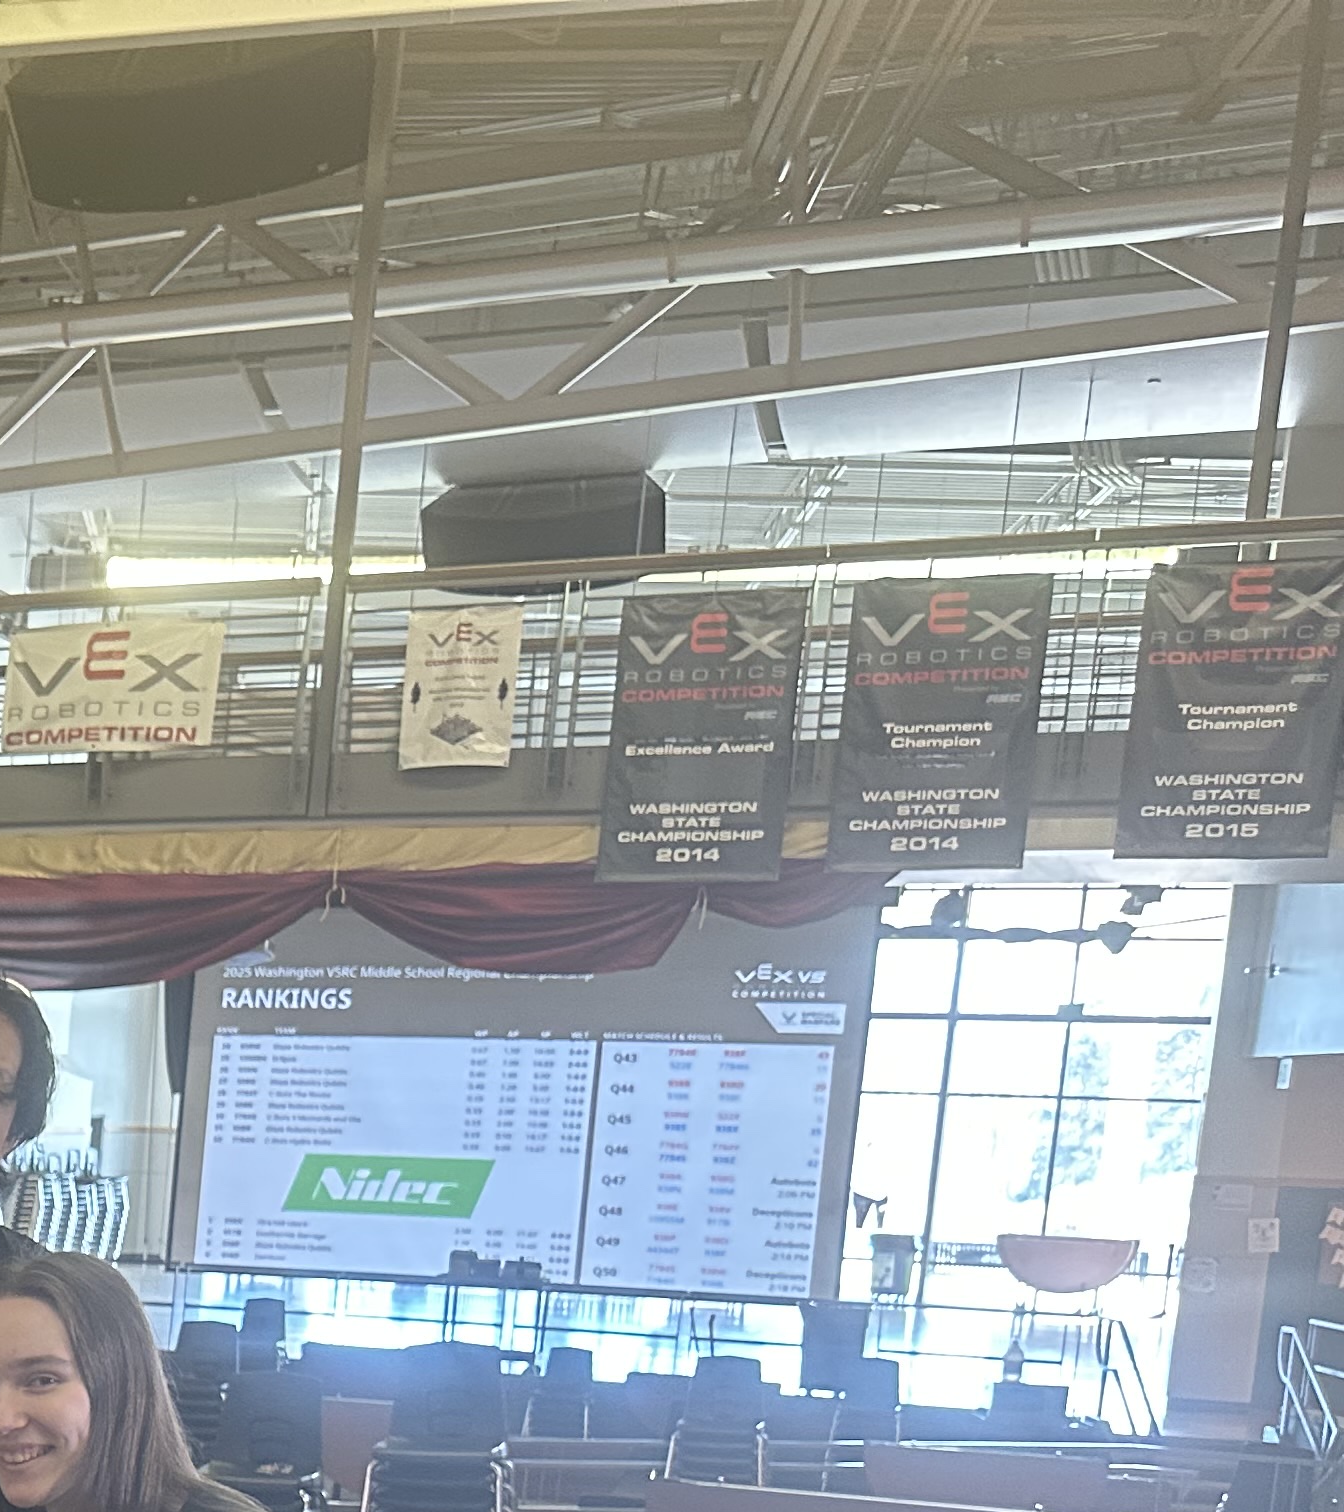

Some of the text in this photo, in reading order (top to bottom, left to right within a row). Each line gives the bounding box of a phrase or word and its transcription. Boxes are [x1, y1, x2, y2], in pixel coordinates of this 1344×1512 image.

[1158, 566, 1344, 624] VEX
[862, 592, 1034, 647] VEX
[428, 622, 500, 648] VEX
[628, 613, 789, 665] VEX
[1150, 623, 1341, 645] ROBOTICS
[856, 646, 1033, 667] ROBOTICS
[1148, 645, 1338, 665] COMPETITION
[14, 631, 202, 697] VEX
[623, 665, 788, 684] ROBOTICS
[854, 667, 1030, 686] COMPETITION
[622, 685, 785, 704] COMPETITION
[8, 700, 200, 722] ROBOTICS
[1178, 702, 1298, 715] Tournament
[882, 721, 993, 735] Tournament
[1186, 718, 1285, 731] Champion
[5, 726, 197, 746] COMPETITION
[890, 735, 981, 749] Champion
[625, 740, 775, 757] Excellence Award
[1154, 773, 1304, 787] WASHINGTON
[862, 788, 1000, 802] WASHINGTON
[1192, 789, 1261, 801] STATE
[629, 801, 758, 815] WASHINGTON
[897, 804, 960, 816] STATE
[1140, 803, 1311, 817] CHAMPIONSHIP
[662, 816, 721, 828] STATE
[849, 817, 1007, 832] CHAMPIONSHIP
[617, 830, 764, 843] CHAMPIONSHIP
[1185, 823, 1259, 838] 2015
[890, 836, 959, 851] 2014
[656, 847, 720, 863] 2014
[223, 966, 251, 979] 2025
[254, 967, 324, 981] Washington
[360, 966, 402, 979] Middle
[404, 968, 444, 979] School
[735, 963, 792, 983] VEX
[221, 987, 353, 1010] RANKINGS
[732, 990, 825, 998] COMPETITION
[608, 1114, 631, 1125] Q45
[313, 1167, 459, 1205] Nidec
[602, 1175, 626, 1187] Q47
